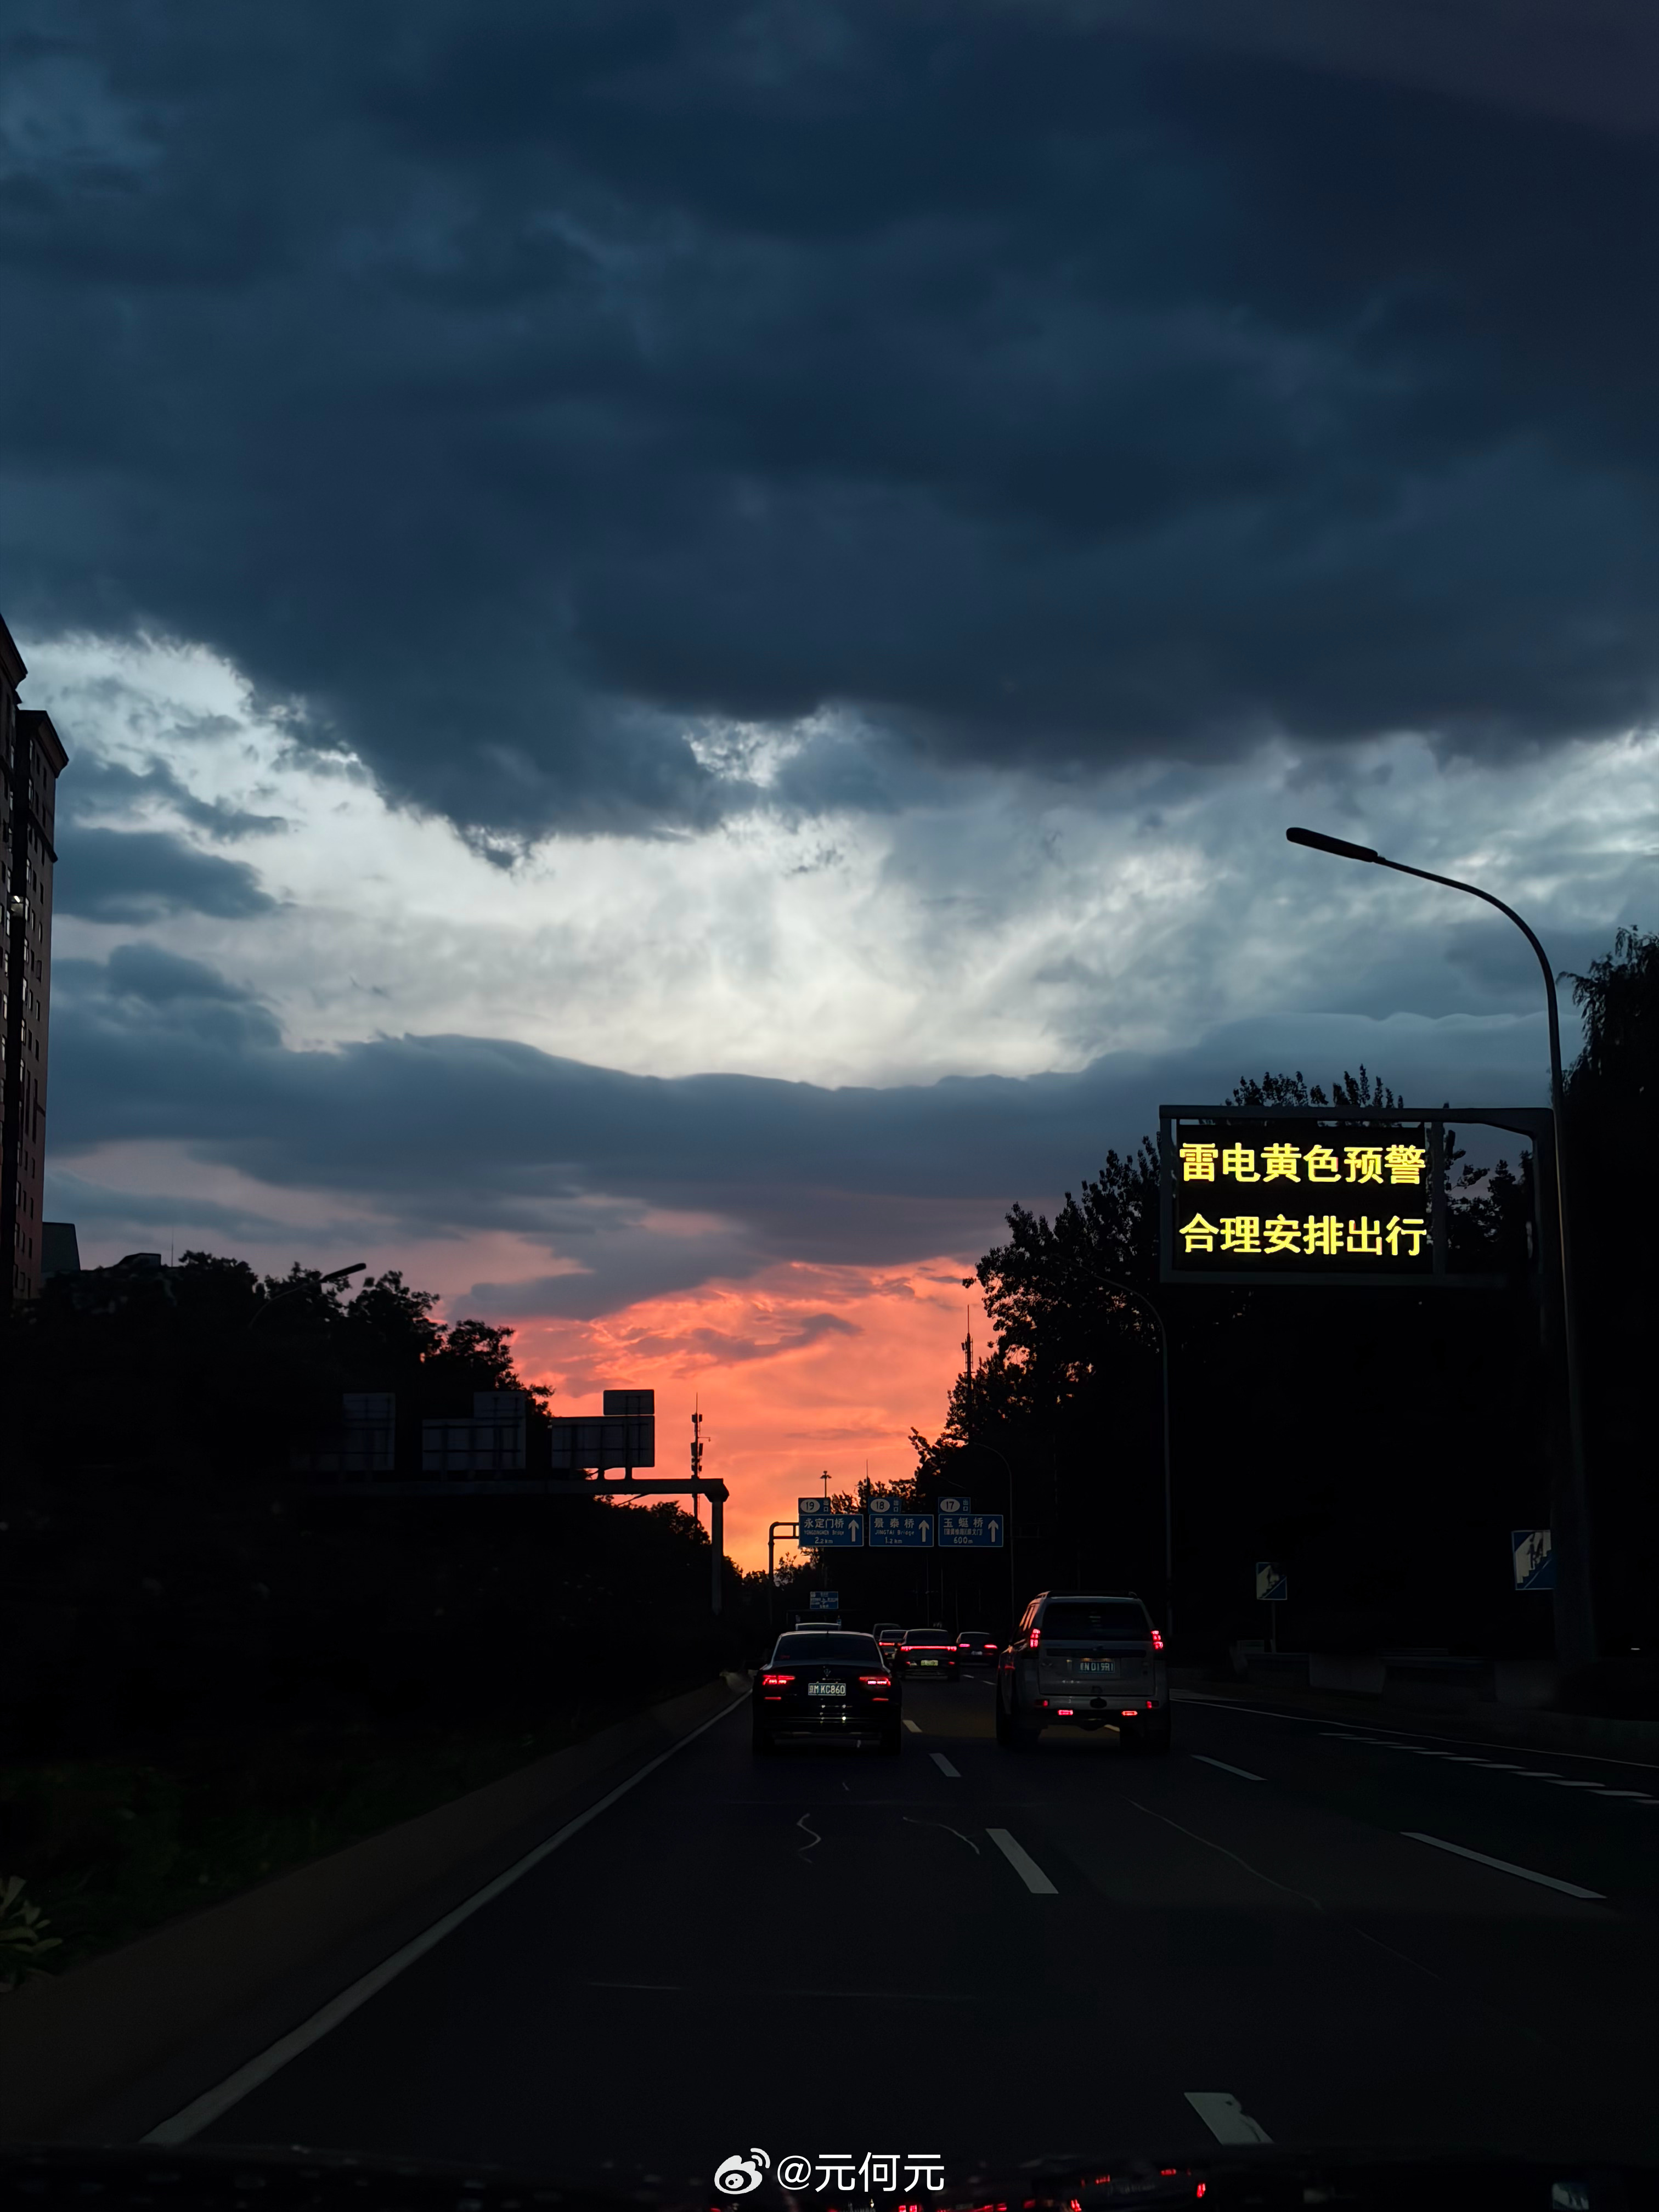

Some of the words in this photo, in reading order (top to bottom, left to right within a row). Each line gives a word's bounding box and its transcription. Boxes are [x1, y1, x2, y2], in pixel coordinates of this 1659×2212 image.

[1179, 1142, 1426, 1184] 雷电黄色预警
[1179, 1212, 1427, 1256] 合理安排出行
[806, 1502, 815, 1510] 19
[876, 1501, 884, 1510] 18
[946, 1501, 955, 1510] 17
[804, 1517, 844, 1529] 永定门桥
[873, 1517, 915, 1528] 景泰桥
